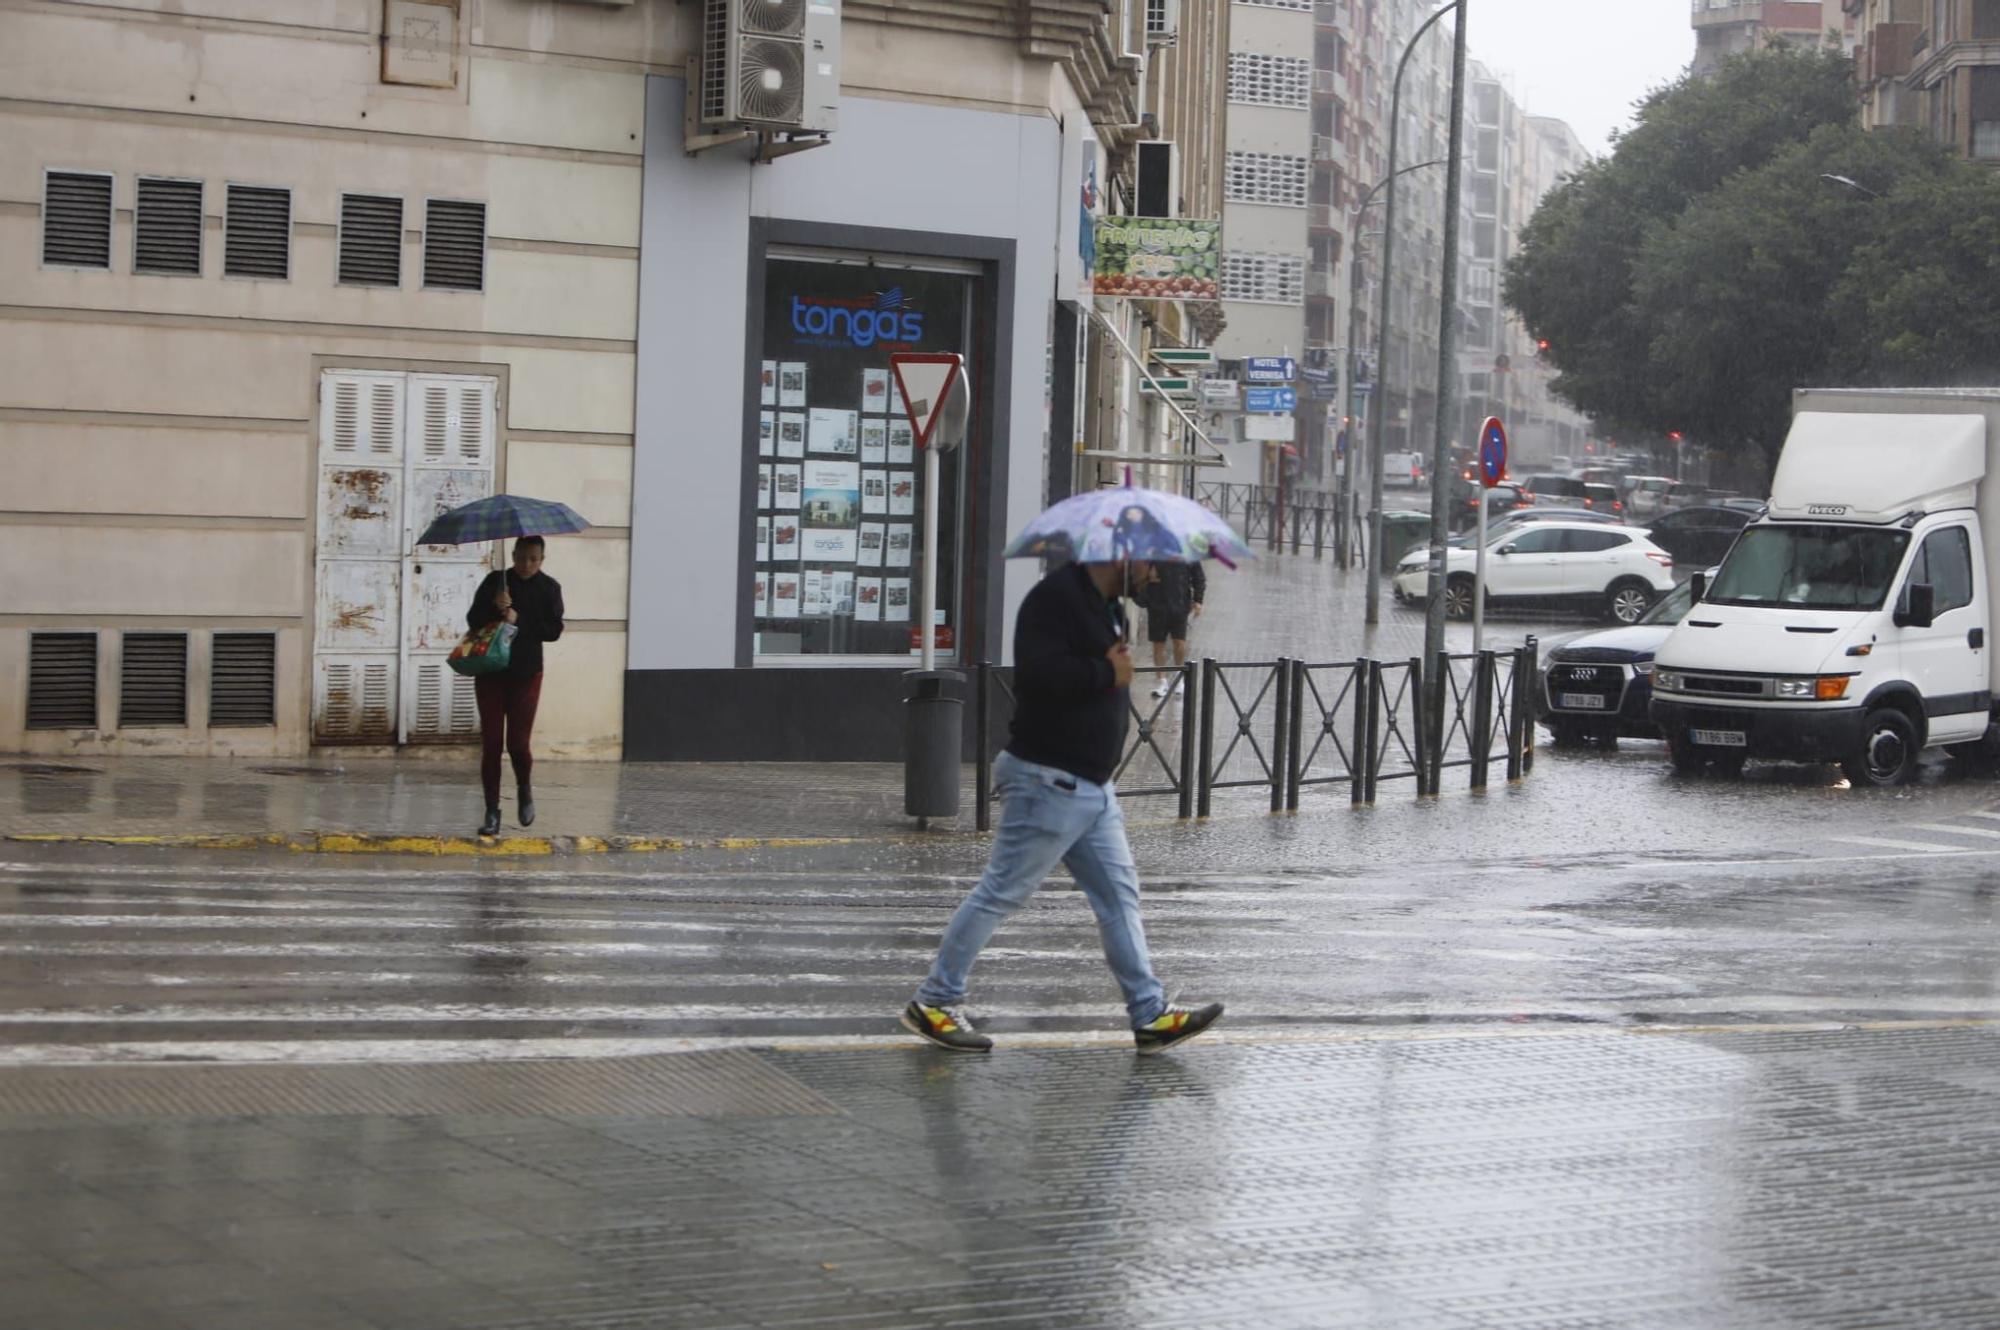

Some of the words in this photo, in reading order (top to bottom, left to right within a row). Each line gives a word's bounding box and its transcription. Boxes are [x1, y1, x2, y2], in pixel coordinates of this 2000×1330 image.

[1130, 254, 1175, 273] CRIS
[791, 295, 923, 347] tongas
[1253, 358, 1280, 368] HOTEL
[1809, 506, 1846, 514] IVECO
